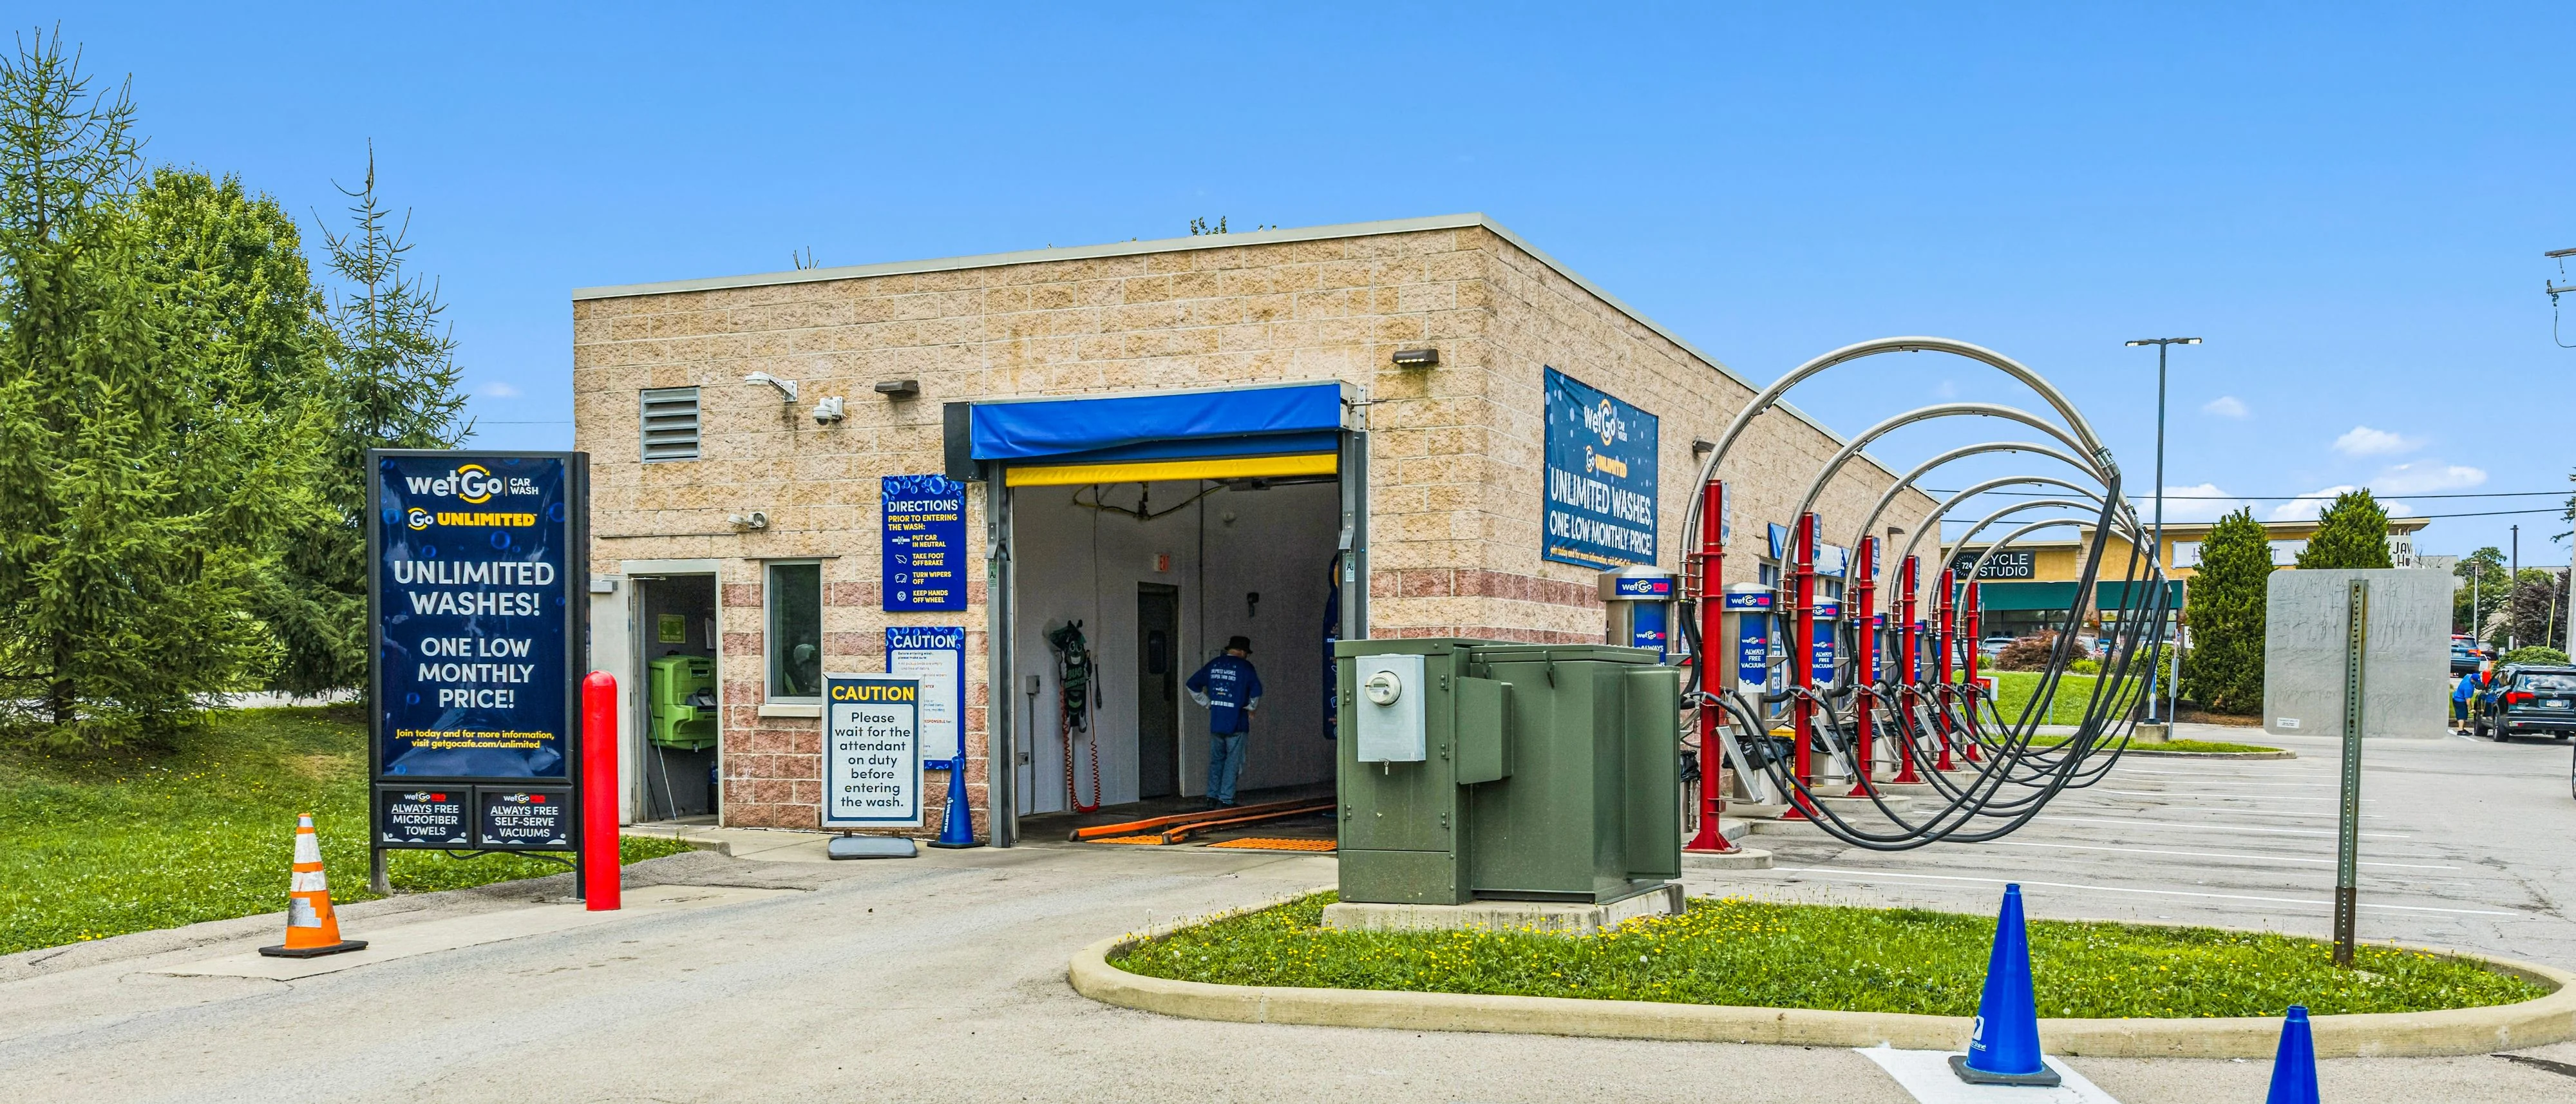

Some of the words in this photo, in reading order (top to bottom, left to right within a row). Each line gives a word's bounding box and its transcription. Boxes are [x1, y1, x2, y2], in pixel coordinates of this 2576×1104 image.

[1584, 404, 1616, 438] wetGo
[1618, 431, 1627, 443] WASH
[1586, 449, 1595, 468] Go
[1595, 453, 1627, 479] UNLIMITED
[406, 470, 502, 497] wetGo
[510, 478, 531, 486] CAR
[510, 486, 539, 495] WASH
[1551, 467, 1609, 515] UNLIMITED
[1611, 486, 1653, 531] WASHES,
[888, 500, 958, 513] DIRECTIONS
[409, 510, 434, 528] Go
[1549, 510, 1569, 538] ONE
[1571, 516, 1590, 542] LOW
[1592, 520, 1629, 550] MONTHLY
[1630, 532, 1652, 557] PRICE!
[394, 560, 554, 585] UNLIMITED
[1980, 566, 2028, 576] STUDIO
[1622, 582, 1652, 591] wetGo
[409, 591, 540, 616] WASHES!
[893, 635, 956, 648] CAUTION
[421, 637, 471, 657] ONE
[479, 638, 531, 658] LOW
[419, 663, 535, 683] MONTHLY
[439, 689, 515, 709] PRICE!
[832, 686, 914, 701] CAUTION
[851, 712, 895, 723] Please
[395, 729, 413, 739] Join
[415, 729, 440, 739] today
[502, 730, 554, 740] information,
[835, 727, 863, 737] wait
[867, 726, 886, 737] for
[889, 727, 911, 737] the
[431, 740, 540, 749] getgocafe.com/unlimited
[840, 741, 905, 751] attendant
[848, 756, 864, 765] on
[868, 754, 898, 768] duty
[851, 768, 895, 779] before
[844, 783, 900, 795] entering
[404, 792, 431, 801] wetGo
[841, 797, 862, 807] the
[866, 797, 904, 807] wash.
[392, 804, 432, 814] ALWAYS
[490, 806, 531, 815] ALWAYS
[534, 806, 558, 815] FREE
[393, 815, 458, 824] MICROFIBER
[495, 817, 554, 826] SELF-SERVE
[404, 826, 446, 835] TOWELS
[499, 828, 550, 837] VACUUMS
